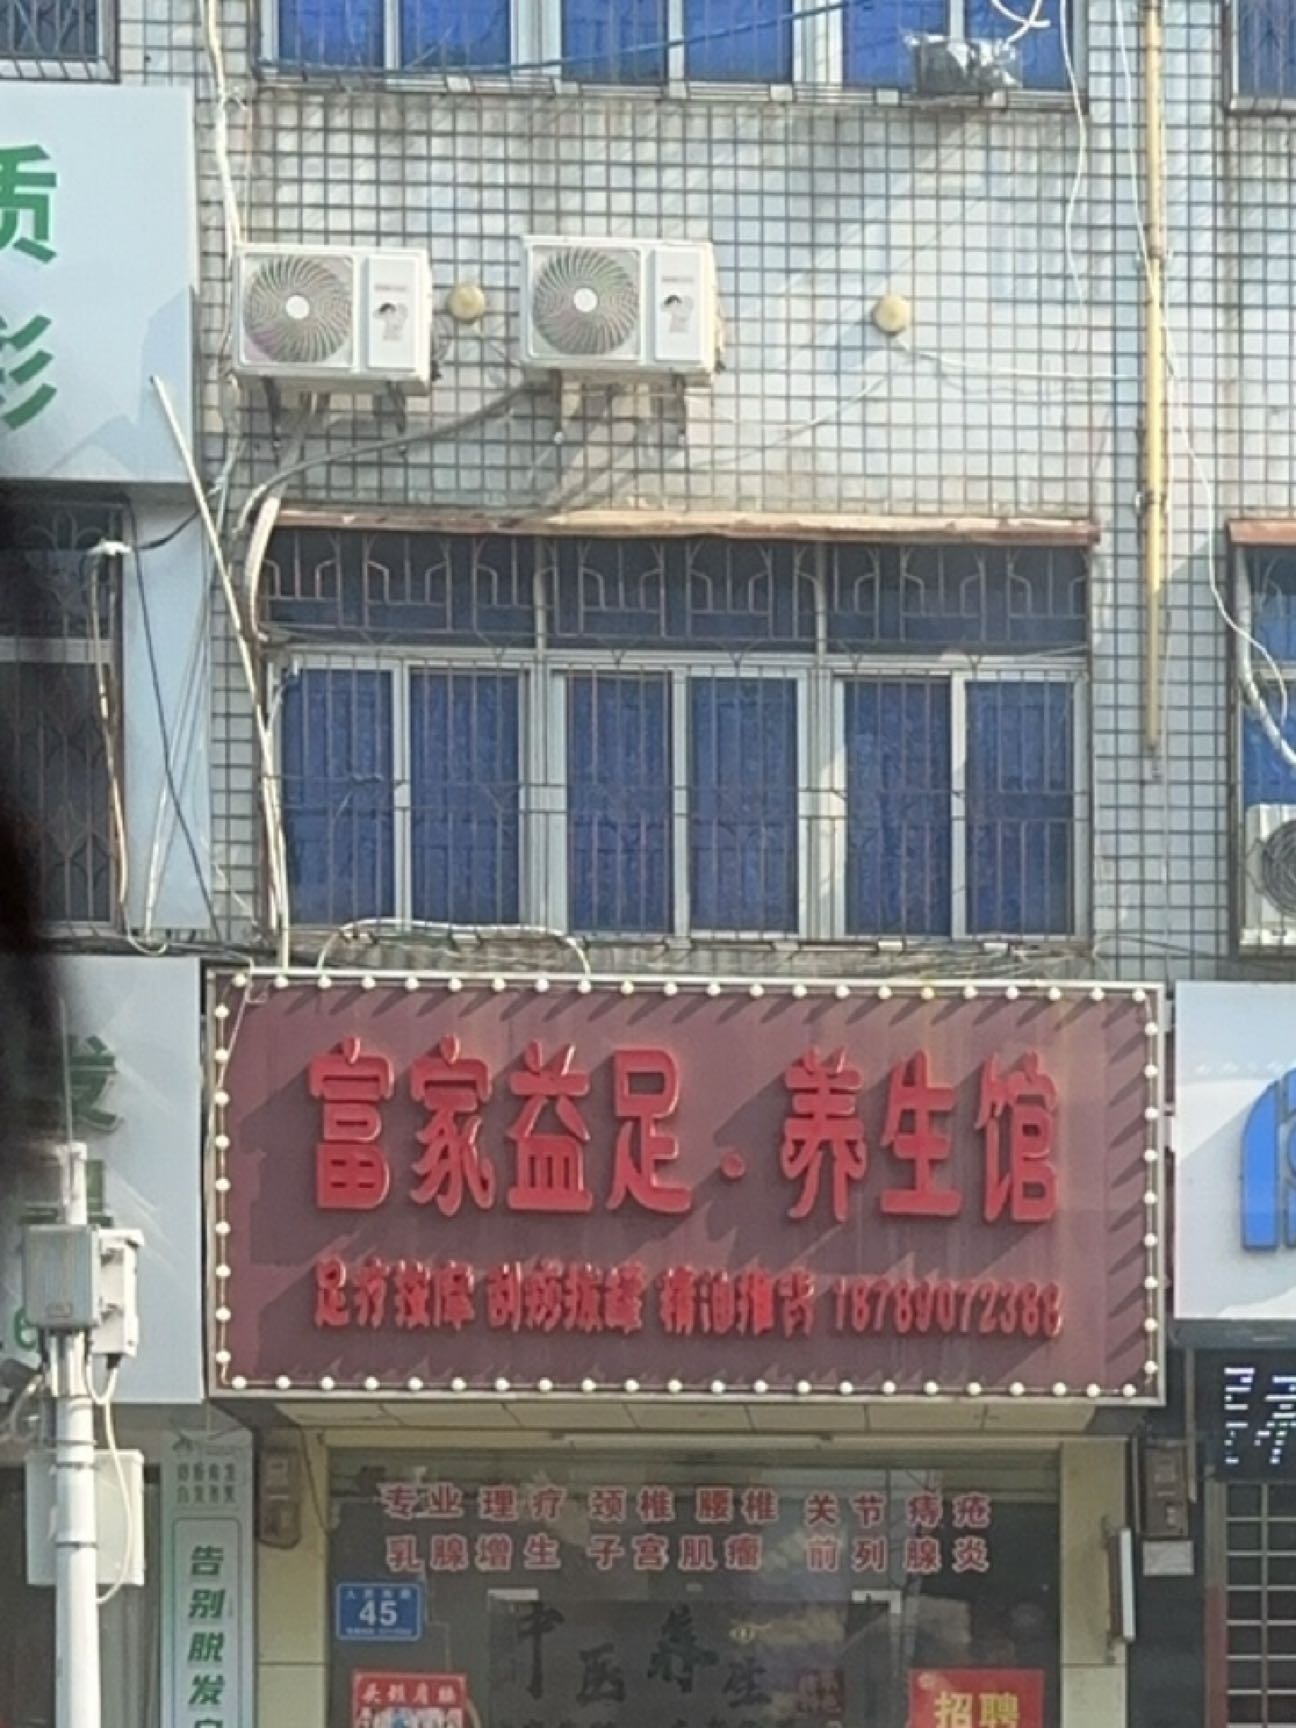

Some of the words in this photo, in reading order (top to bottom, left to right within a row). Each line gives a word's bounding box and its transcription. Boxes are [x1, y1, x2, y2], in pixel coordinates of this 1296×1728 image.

[834, 1276, 1064, 1338] 18789072388
[385, 1532, 562, 1573] 乳腺增生
[585, 1532, 763, 1572] 子宫肌瘤
[805, 1535, 990, 1574] 前列腺炎
[358, 1599, 398, 1627] 45
